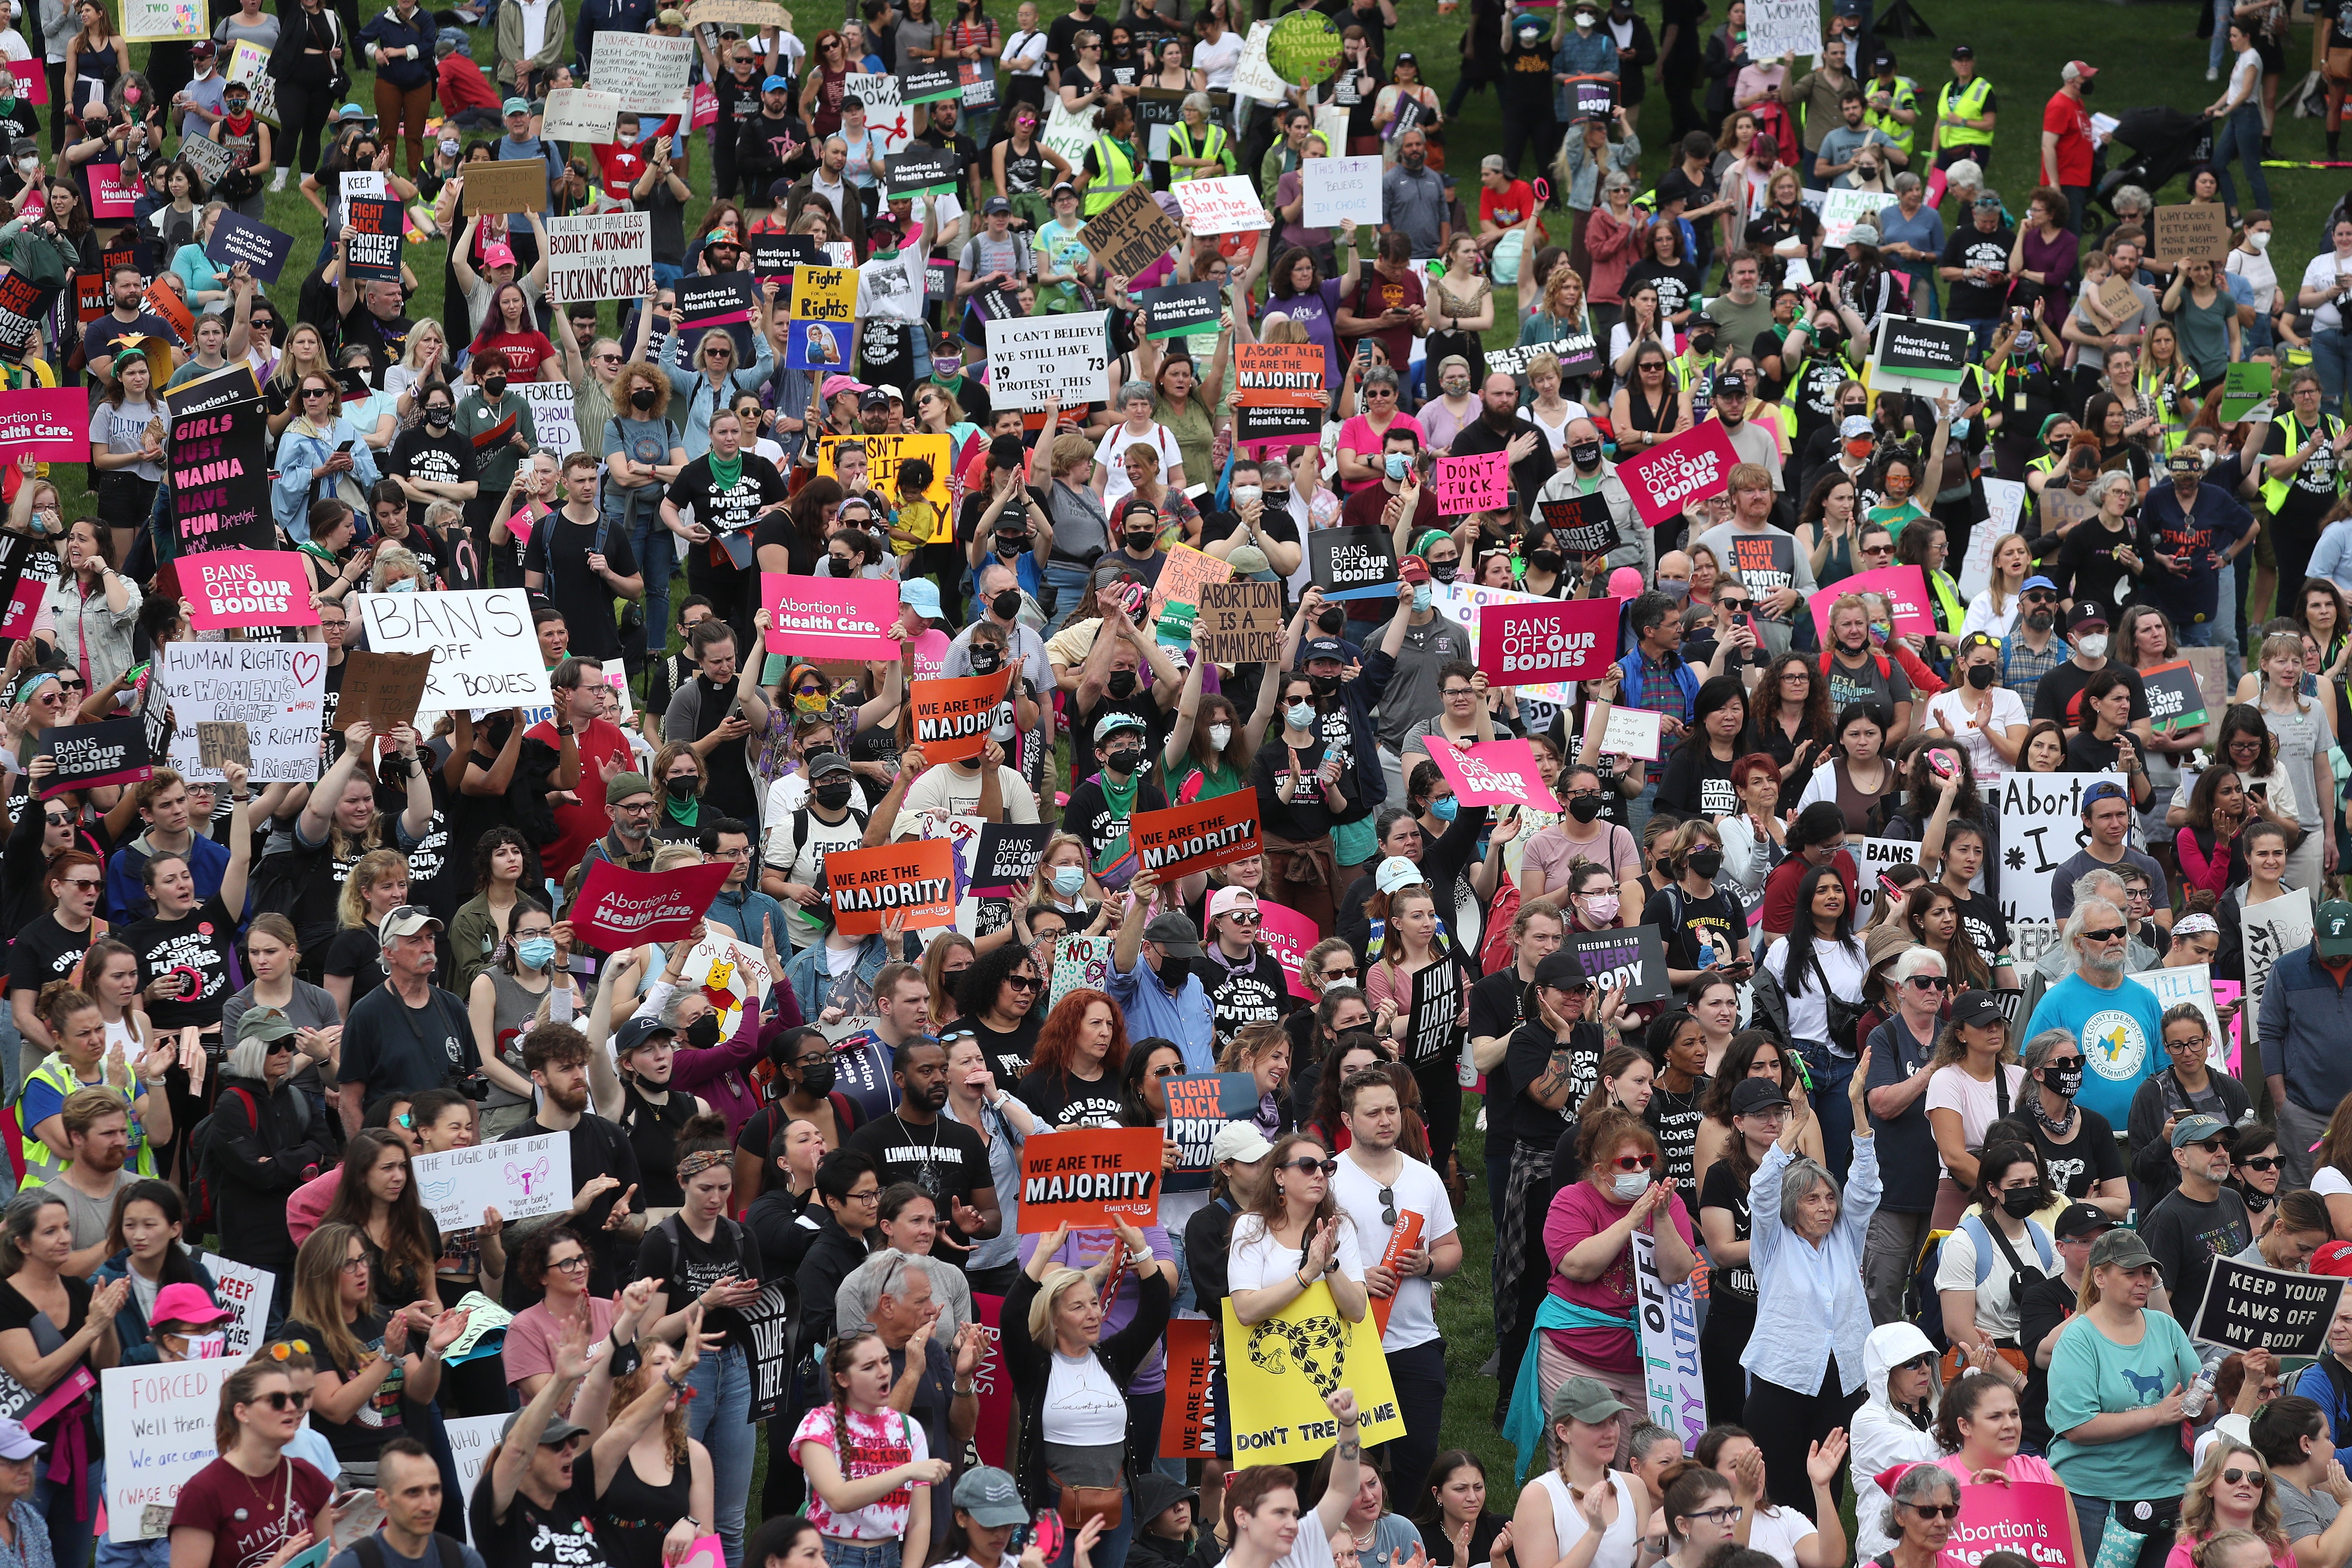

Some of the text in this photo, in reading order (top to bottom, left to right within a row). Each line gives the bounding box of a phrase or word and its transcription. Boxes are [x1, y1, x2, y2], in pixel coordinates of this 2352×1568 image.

[1283, 15, 1322, 32] Grow
[1274, 31, 1340, 45] Abortion
[625, 49, 652, 59] CAPITAL
[1290, 45, 1339, 58] Power
[894, 162, 932, 173] Abortion
[894, 170, 946, 182] Health Care.
[1312, 162, 1335, 175] THIS
[348, 176, 371, 190] KEEP
[469, 172, 532, 185] ABORTION
[1324, 179, 1363, 191] BELIEVES
[492, 186, 508, 194] IS
[352, 202, 384, 219] FIGHT
[1314, 199, 1367, 212] IN CHOICE
[551, 215, 643, 232] I WILL NOT HAVE LESS
[1086, 186, 1151, 254] ABORTION
[2161, 212, 2180, 221] WHY
[2184, 211, 2205, 220] DOES
[351, 218, 383, 234] BACK.
[1116, 218, 1141, 245] IS
[2161, 224, 2211, 233] FETUS HAVE
[236, 226, 272, 246] Vote Out
[350, 233, 398, 250] PROTECT
[550, 231, 644, 255] BODILY AUTONOMY
[2161, 235, 2218, 245] MORE RIGHTS
[225, 233, 273, 258] Anti-Choice
[2161, 245, 2210, 256] THAN ME??
[225, 243, 266, 266] Politicians
[349, 247, 393, 266] CHOICE.
[581, 254, 616, 266] THAN A
[551, 265, 651, 300] FUCKING CORPSE
[808, 270, 842, 289] Fight
[801, 300, 848, 320] Rights
[1001, 327, 1104, 344] I CAN'T BELIEVE
[995, 345, 1090, 362] WE STILL HAVE
[995, 366, 1010, 380] 19
[1038, 364, 1055, 373] TO
[1087, 358, 1104, 371] 73
[998, 377, 1091, 392] PROTEST THIS
[176, 413, 233, 441] GIRLS
[174, 438, 223, 464] JUST
[175, 458, 244, 490] WANNA
[1446, 462, 1495, 479] DON'T
[1448, 479, 1493, 495] FUCK
[178, 487, 228, 512] HAVE
[1441, 495, 1493, 511] WITH US
[180, 507, 257, 537] FUN DAMENTAL
[202, 564, 257, 582] BANS
[205, 580, 293, 597] OFF OUR
[1201, 583, 1279, 609] ABORTION
[211, 597, 288, 614] BODIES
[1219, 611, 1255, 630] IS A
[1504, 616, 1560, 637] BANS
[1202, 633, 1245, 662] HUMAN
[1502, 632, 1595, 655] OFF OUR
[172, 649, 290, 671] HUMAN RIGHTS
[1502, 650, 1586, 673] BODIES
[167, 676, 295, 703] are WOMEN'S
[698, 943, 720, 958] OH,
[1577, 941, 1610, 951] FREEDOM
[1624, 937, 1638, 946] FOR
[1579, 946, 1641, 976] EVERY
[1423, 959, 1453, 1001] HOW
[1420, 989, 1458, 1032] DARE
[1979, 998, 1994, 1008] alo
[1415, 1022, 1452, 1059] THEY.
[2096, 1061, 2138, 1078] COMMITTEE
[420, 1157, 442, 1172] THE
[451, 1151, 483, 1166] LOGIC
[488, 1147, 500, 1158] OF
[504, 1145, 519, 1155] THE
[885, 1146, 963, 1164] LINKIN PARK
[1029, 1155, 1121, 1173] WE ARE THE
[1026, 1172, 1155, 1204] MAJORITY
[2195, 1220, 2239, 1241] GRATEFUL DEAD
[2229, 1271, 2327, 1302] KEEP YOUR
[2227, 1298, 2317, 1325] LAWS OFF
[2226, 1323, 2305, 1348] MY BODY
[1093, 1404, 1102, 1413] go
[1237, 1402, 1396, 1451] DON'T TRE ON ME
